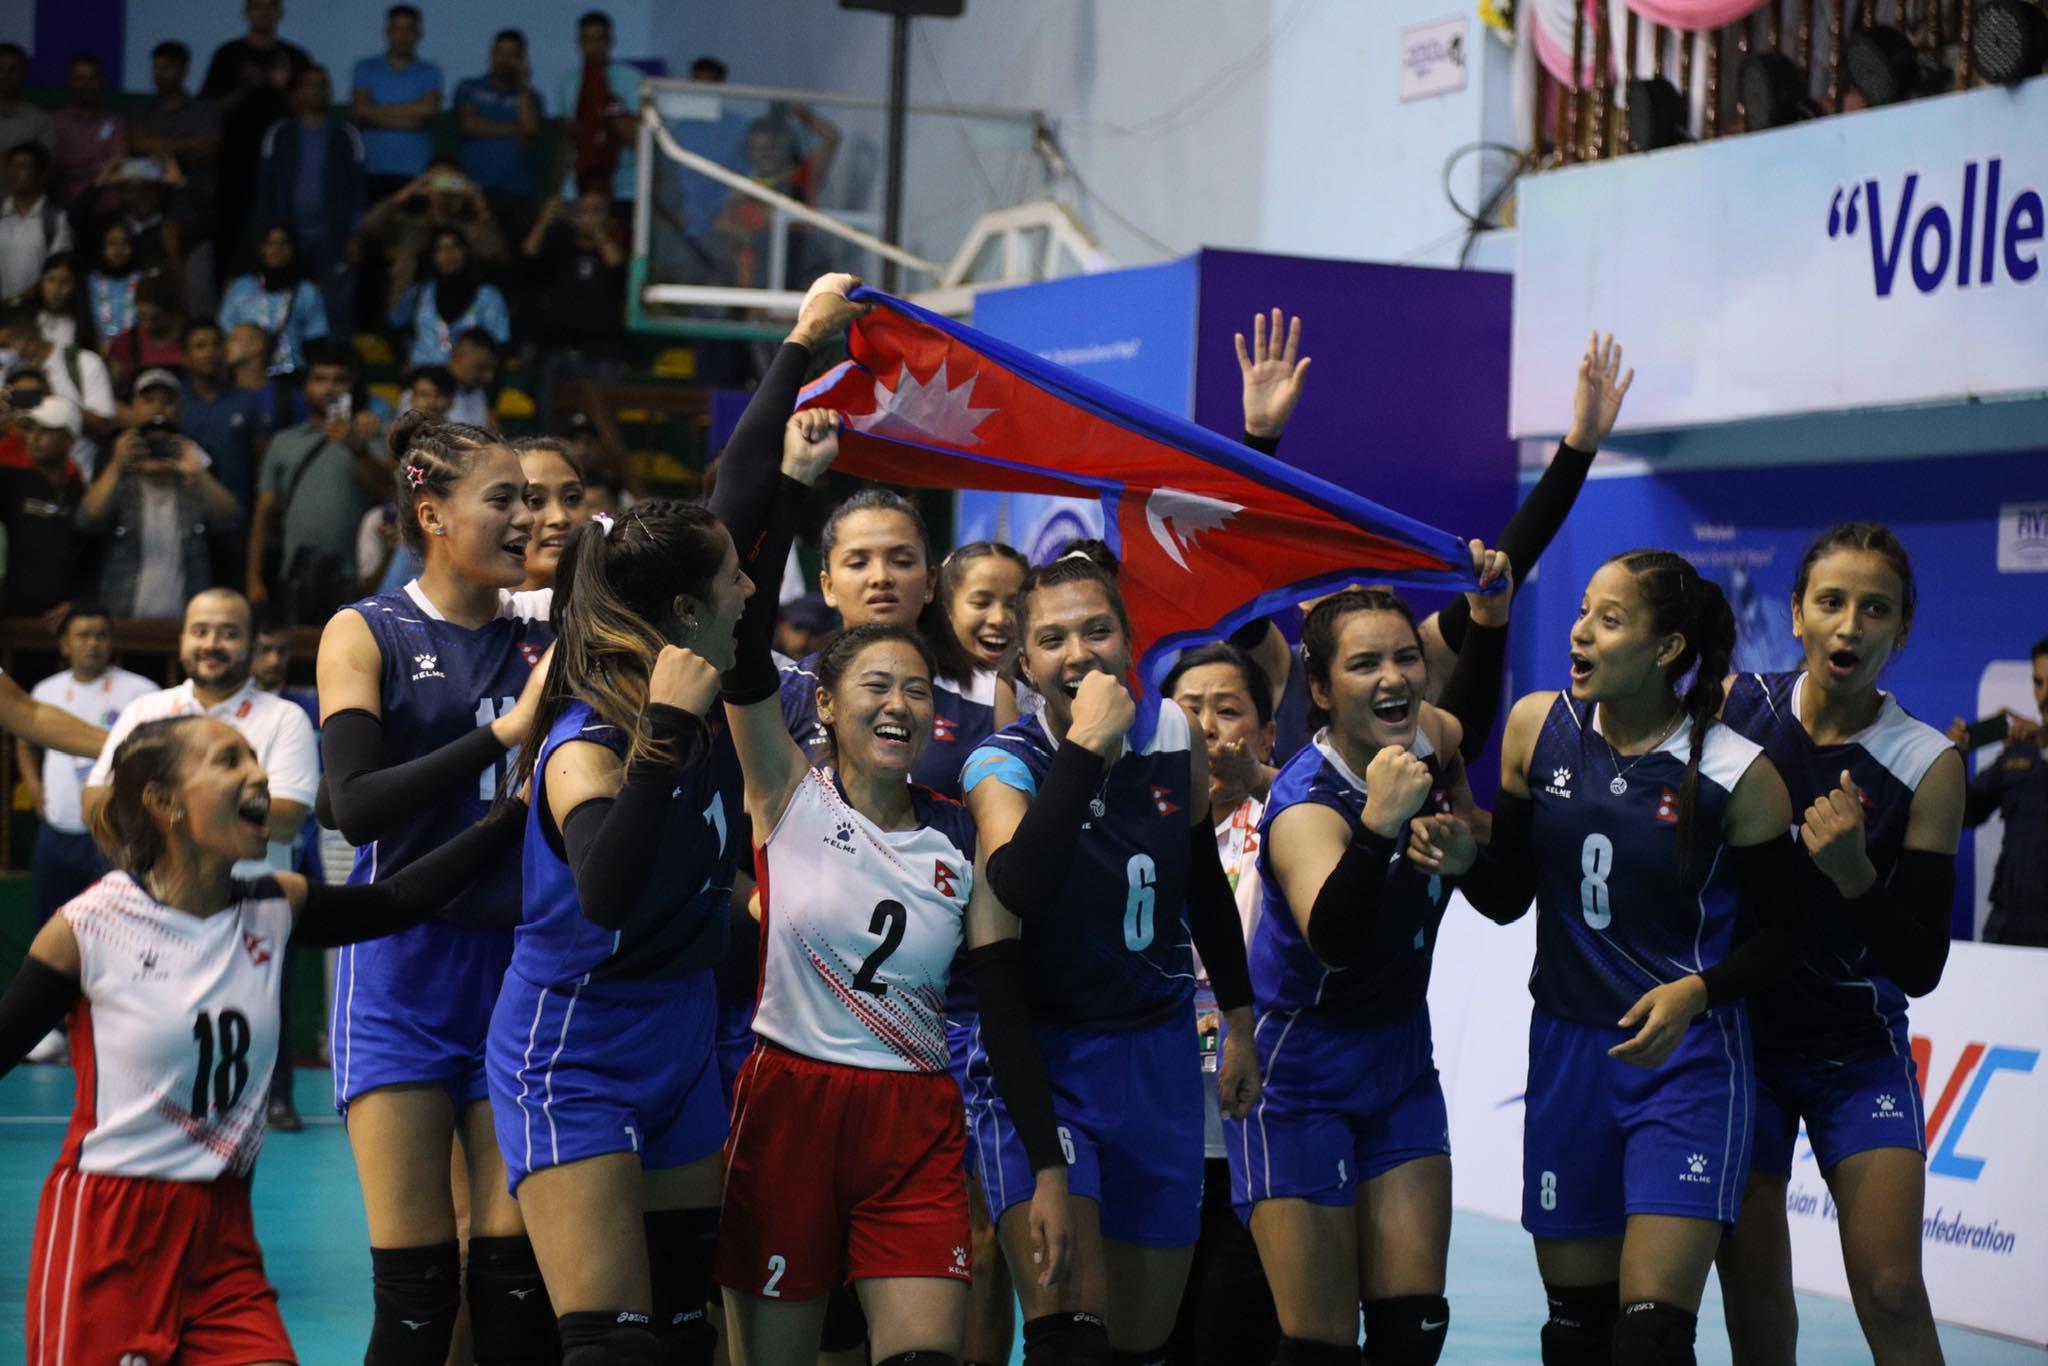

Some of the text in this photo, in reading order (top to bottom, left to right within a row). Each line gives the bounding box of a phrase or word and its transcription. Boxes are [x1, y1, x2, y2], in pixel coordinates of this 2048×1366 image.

[1545, 785, 1572, 799] KELME
[823, 835, 858, 855] KELME
[1123, 853, 1157, 952] 6
[1580, 832, 1614, 931] 8
[850, 899, 907, 995] 2
[190, 1008, 251, 1120] 18
[1872, 1111, 1904, 1119] KELME
[1911, 1034, 2042, 1183] VC
[1057, 1126, 1076, 1165] 6
[1540, 1170, 1557, 1211] 8
[1679, 1173, 1711, 1184] KELME
[1787, 1184, 1819, 1216] sian
[1922, 1206, 2016, 1254] nfederation
[762, 1254, 786, 1297] 2
